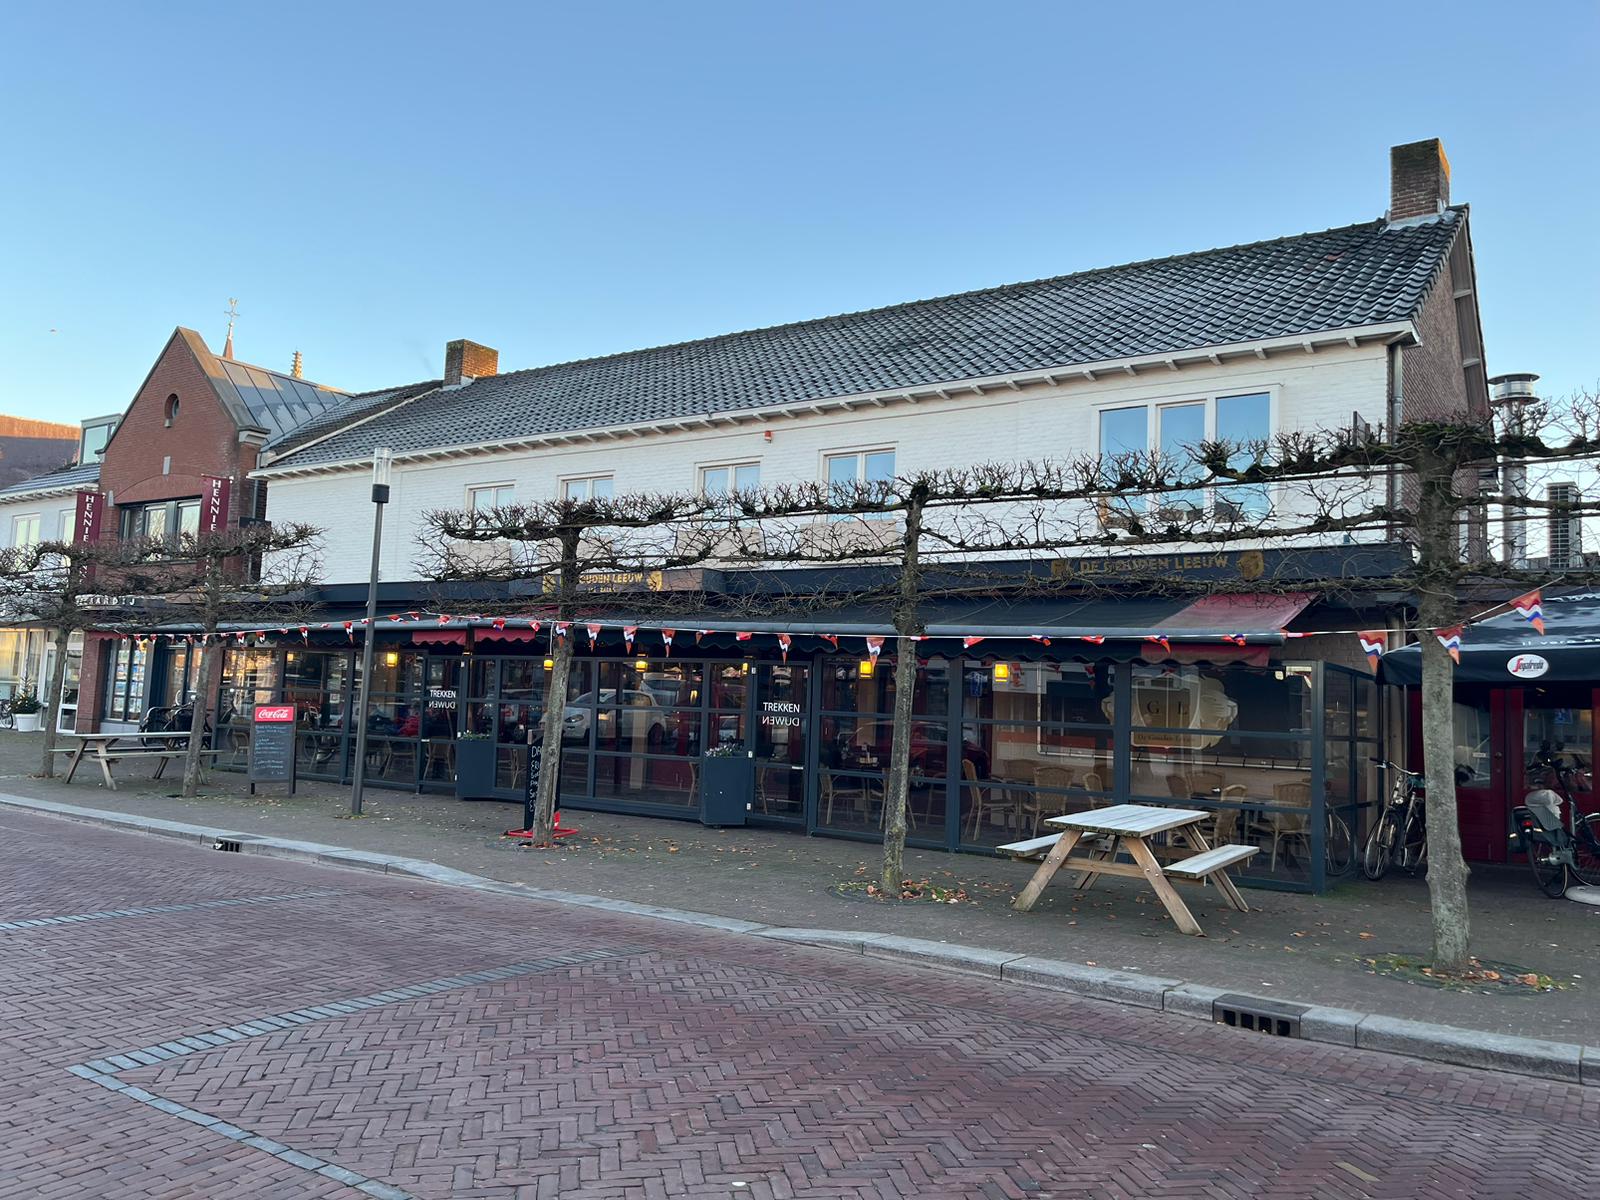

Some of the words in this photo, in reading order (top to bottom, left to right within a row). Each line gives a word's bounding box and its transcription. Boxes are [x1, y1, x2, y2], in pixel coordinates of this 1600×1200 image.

[210, 479, 222, 532] HENNIE
[82, 494, 95, 543] HENNIE
[1174, 555, 1227, 570] LEEUW
[612, 571, 643, 583] LEEUW
[429, 689, 457, 699] TREKKEN
[762, 702, 800, 713] TREKKEN
[1147, 700, 1160, 715] G
